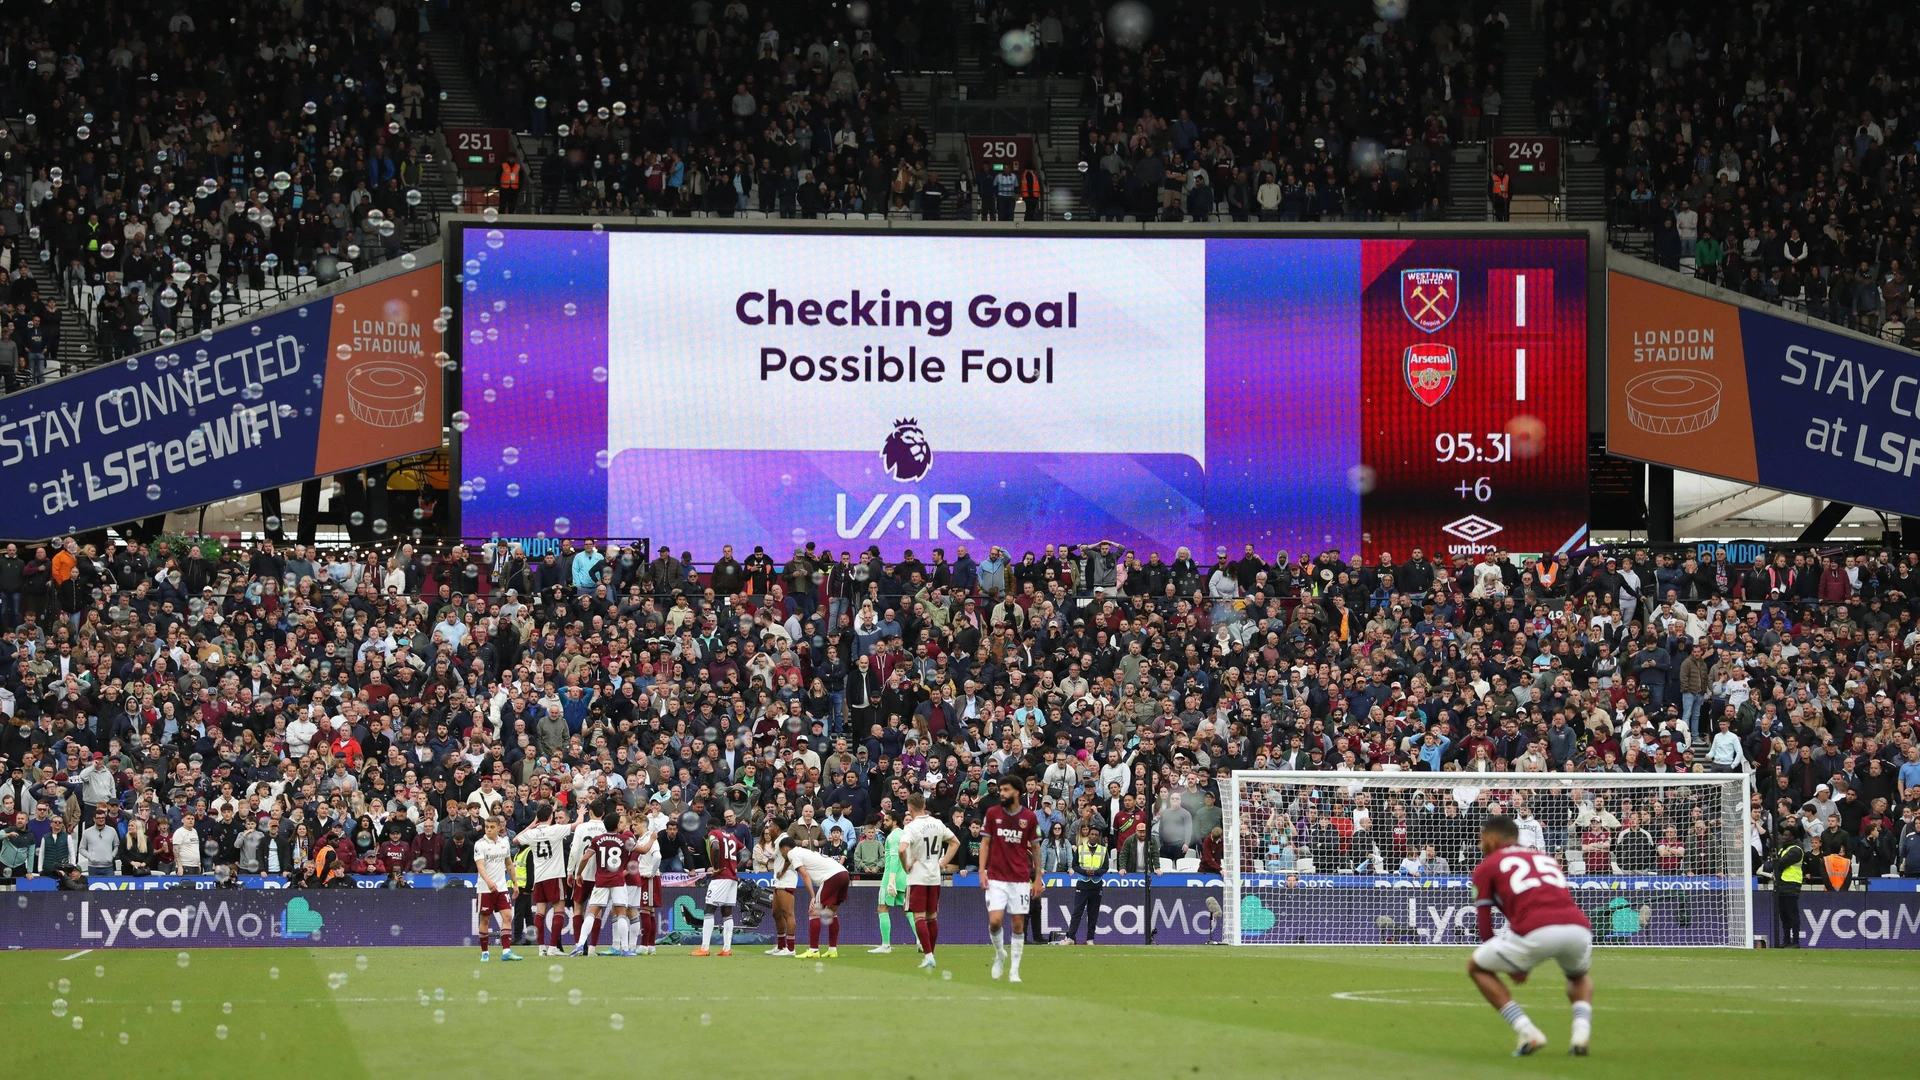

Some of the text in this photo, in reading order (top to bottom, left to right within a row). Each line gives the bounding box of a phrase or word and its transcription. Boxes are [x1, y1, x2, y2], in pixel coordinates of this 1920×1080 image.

[458, 133, 493, 150] 251
[983, 142, 1017, 158] 250
[1508, 142, 1544, 159] 249
[1407, 272, 1453, 281] WEST HAM
[735, 289, 1077, 337] Checking Goal
[353, 319, 420, 337] LONDON
[1634, 329, 1714, 346] LONDON
[353, 337, 422, 354] STADIUM
[1634, 346, 1714, 362] STADIUM
[760, 345, 1053, 384] Possible Foul
[1410, 353, 1449, 364] Arsenal
[1780, 344, 1920, 420] STAY C
[0, 334, 301, 466] STAY CONNECTED
[1435, 432, 1511, 462] 95:31
[1805, 417, 1848, 457] at
[42, 469, 78, 516] at
[1454, 476, 1492, 502] +6
[836, 493, 975, 540] VAR
[491, 538, 560, 557] BWDOG
[1448, 543, 1497, 554] umbro
[1697, 543, 1767, 564] BRWDOG
[997, 828, 1023, 839] BOYLE
[599, 846, 622, 869] 18
[723, 838, 737, 860] 12
[923, 835, 939, 860] 14
[1499, 855, 1567, 895] 25
[642, 892, 649, 901] 8
[1019, 894, 1029, 906] 19
[1797, 903, 1920, 947] ycaM
